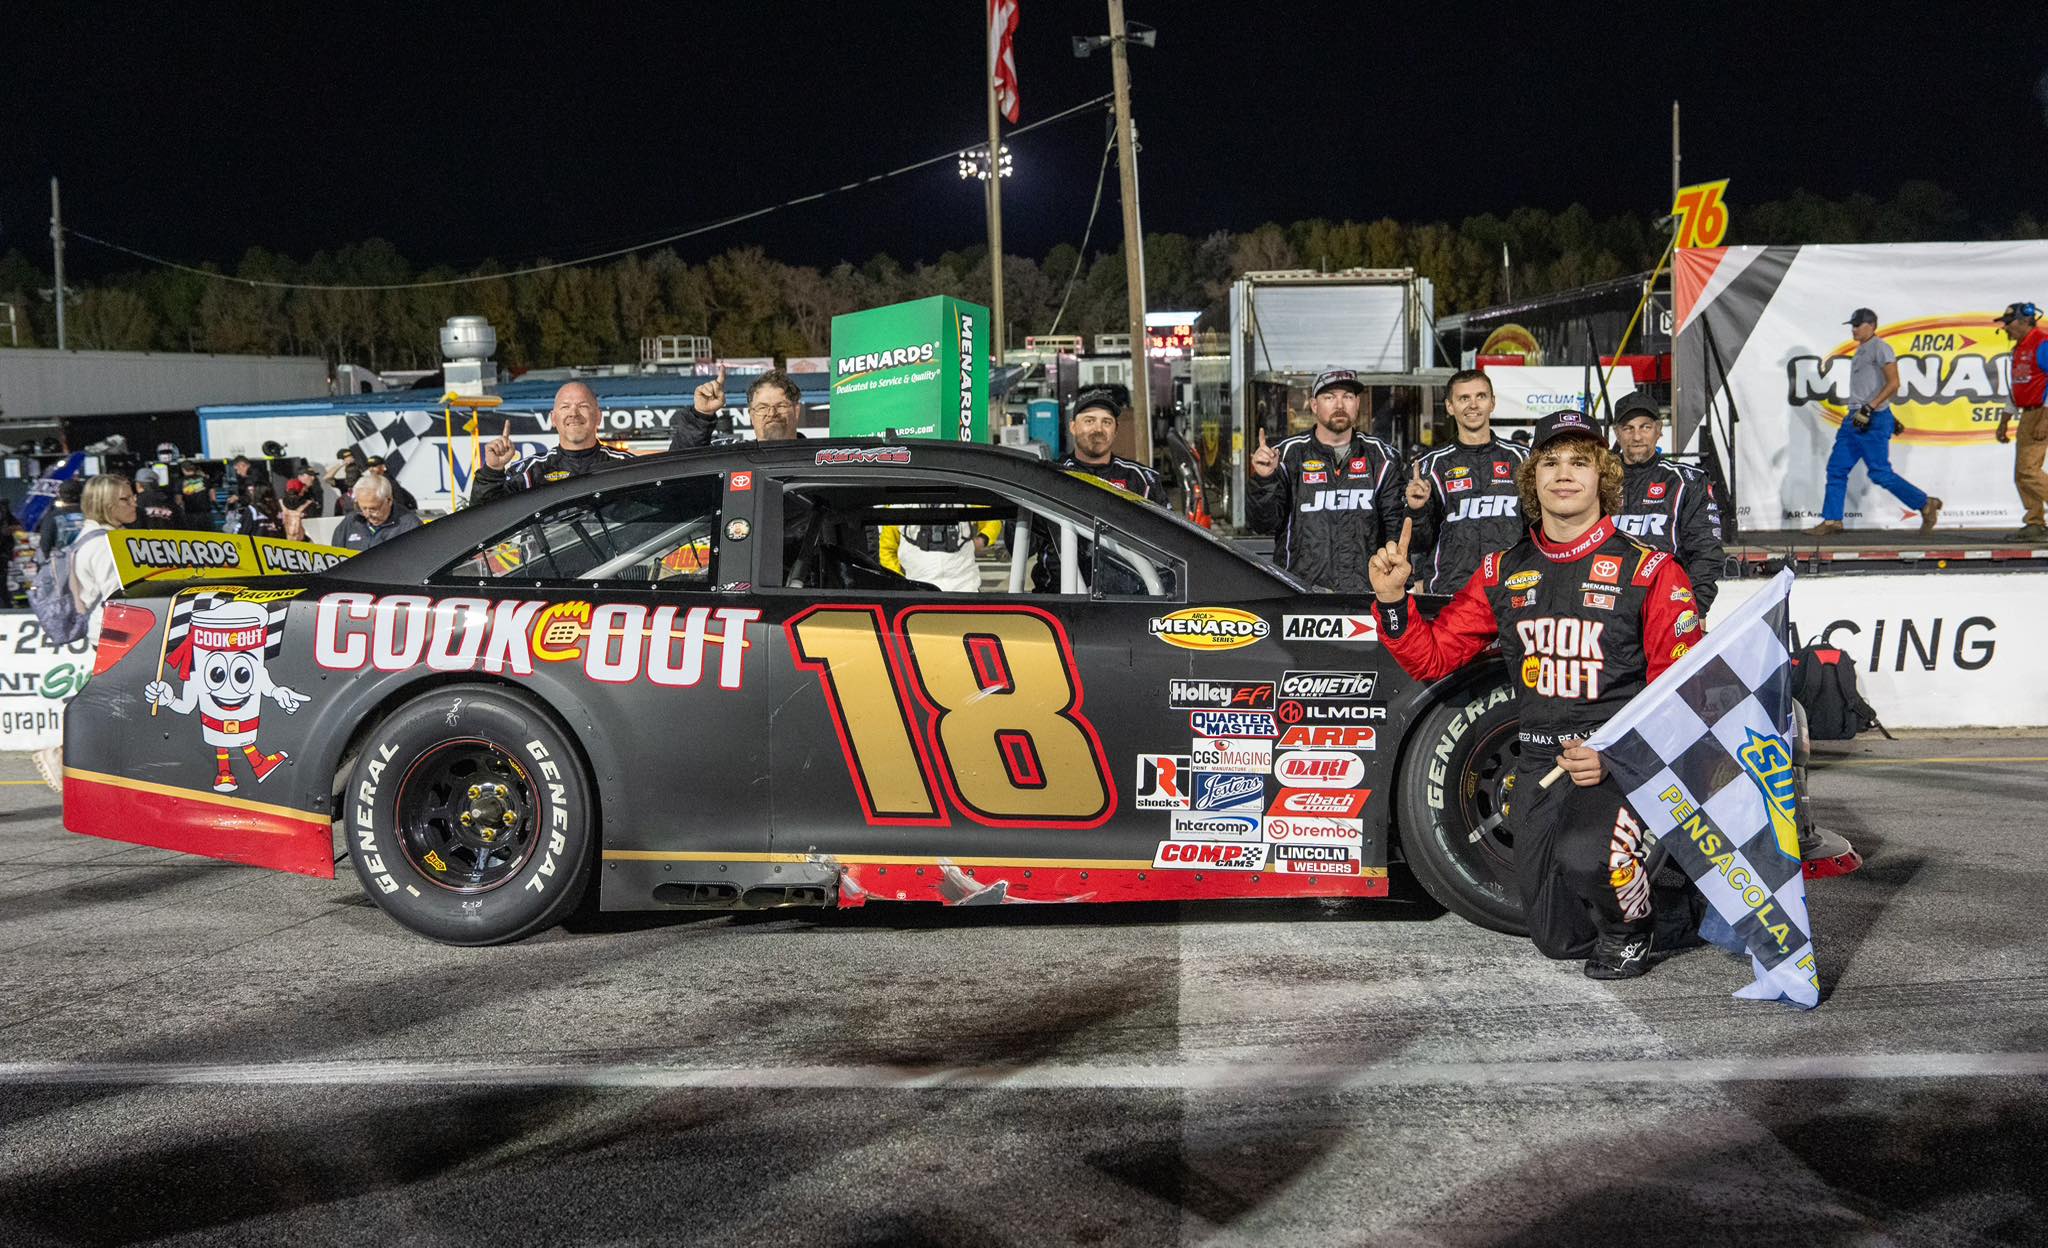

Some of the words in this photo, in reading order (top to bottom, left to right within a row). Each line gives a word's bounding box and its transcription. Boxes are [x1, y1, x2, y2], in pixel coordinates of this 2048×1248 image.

[1672, 178, 1729, 248] 76
[1909, 334, 1954, 352] ARCA
[837, 342, 934, 377] MENARDS
[836, 381, 869, 395] Dedicated
[870, 379, 877, 389] to
[878, 375, 902, 388] Service
[904, 374, 910, 383] &
[911, 370, 936, 384] Quality
[960, 313, 973, 442] MENARDS
[1526, 394, 1574, 404] CYCLUM
[1300, 489, 1374, 512] JGR
[1446, 495, 1518, 522] JGR
[126, 537, 240, 569] MENARDS
[263, 544, 349, 574] MENAR
[1505, 574, 1542, 588] MENARDS
[1582, 583, 1621, 593] MENARDS
[194, 629, 230, 648] COOK
[238, 628, 263, 647] OUT
[1149, 617, 1270, 639] MENARDS
[1286, 618, 1344, 638] ARCA
[314, 593, 548, 675] COOK
[585, 603, 763, 690] OUT
[1516, 618, 1604, 659] COOK
[1283, 676, 1373, 694] COMETIC
[1539, 658, 1604, 700] OUT
[1172, 683, 1232, 707] Holley
[1232, 685, 1272, 706] EFI
[783, 604, 1118, 830] 18
[1192, 712, 1271, 729] QUARTER
[1306, 706, 1387, 718] ILMOR
[1206, 723, 1275, 736] MASTER
[1280, 727, 1374, 746] ARP
[1532, 734, 1554, 745] MAX
[1285, 758, 1357, 777] DART
[1196, 773, 1263, 810] Jostens
[1137, 798, 1180, 808] shocks
[1284, 792, 1355, 813] Eibach
[357, 743, 400, 895] GENERAL
[525, 739, 568, 893] GENERAL
[1175, 818, 1249, 836] Intercomp
[1293, 823, 1358, 839] brembo
[1160, 844, 1243, 863] COMP
[1280, 847, 1345, 860] LINCOLN
[1215, 860, 1254, 868] CAMS
[1294, 861, 1352, 873] WELDERS
[1658, 784, 1790, 953] PENSACOLA,
